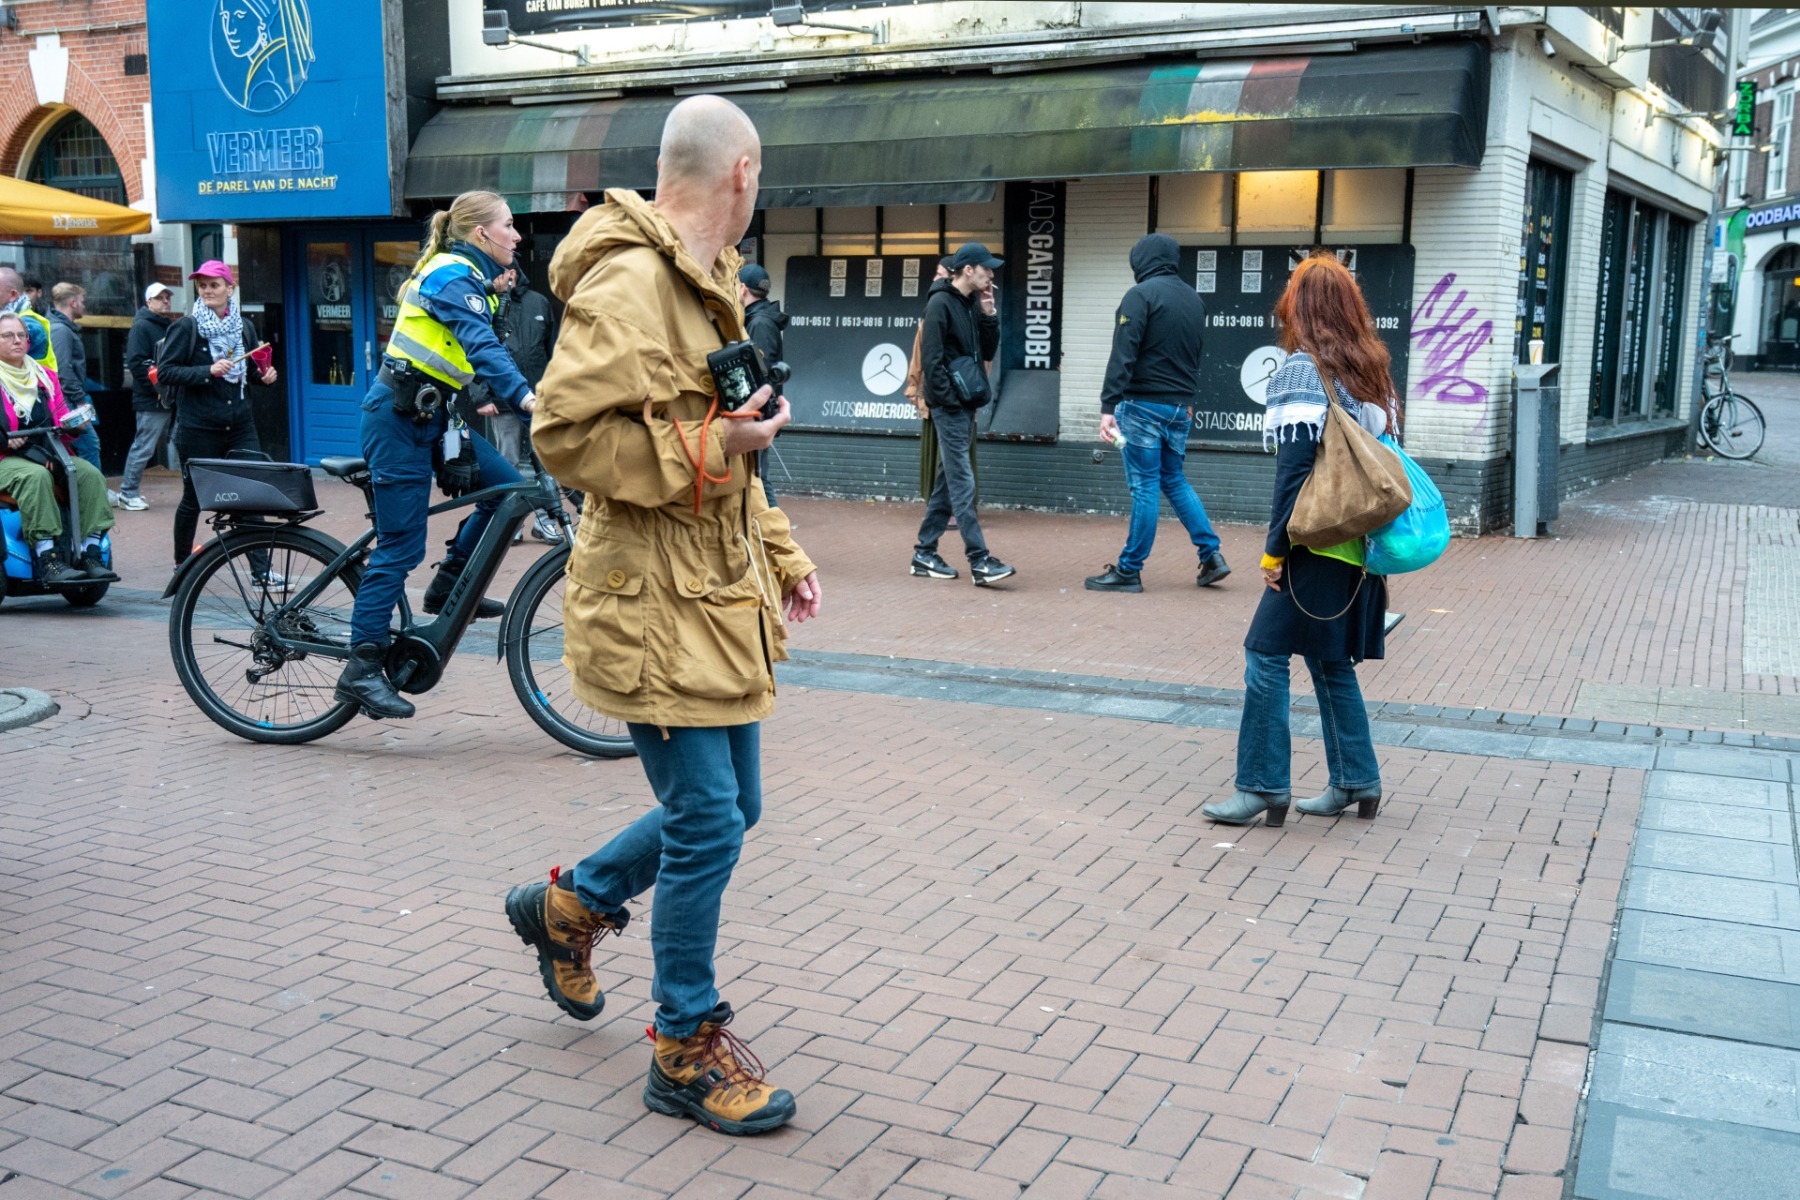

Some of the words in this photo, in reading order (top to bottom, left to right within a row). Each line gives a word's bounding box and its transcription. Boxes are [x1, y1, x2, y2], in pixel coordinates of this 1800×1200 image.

[546, 0, 562, 11] VAN
[1735, 83, 1753, 134] ZORBA
[206, 125, 324, 174] VERMEER
[198, 181, 214, 195] DE
[216, 180, 251, 193] PAREL
[253, 179, 276, 191] VAN
[279, 178, 295, 190] DE
[297, 175, 338, 189] NACHT
[1746, 204, 1800, 228] OODBAR
[1024, 182, 1055, 369] ADSGARDEROBE
[316, 304, 351, 318] VERMEER
[791, 316, 831, 327] 0001-0512
[841, 316, 883, 327] 0513-0816
[894, 317, 922, 328] 0817-1
[1212, 315, 1264, 328] 0513-0816
[444, 568, 473, 618] CUBE
